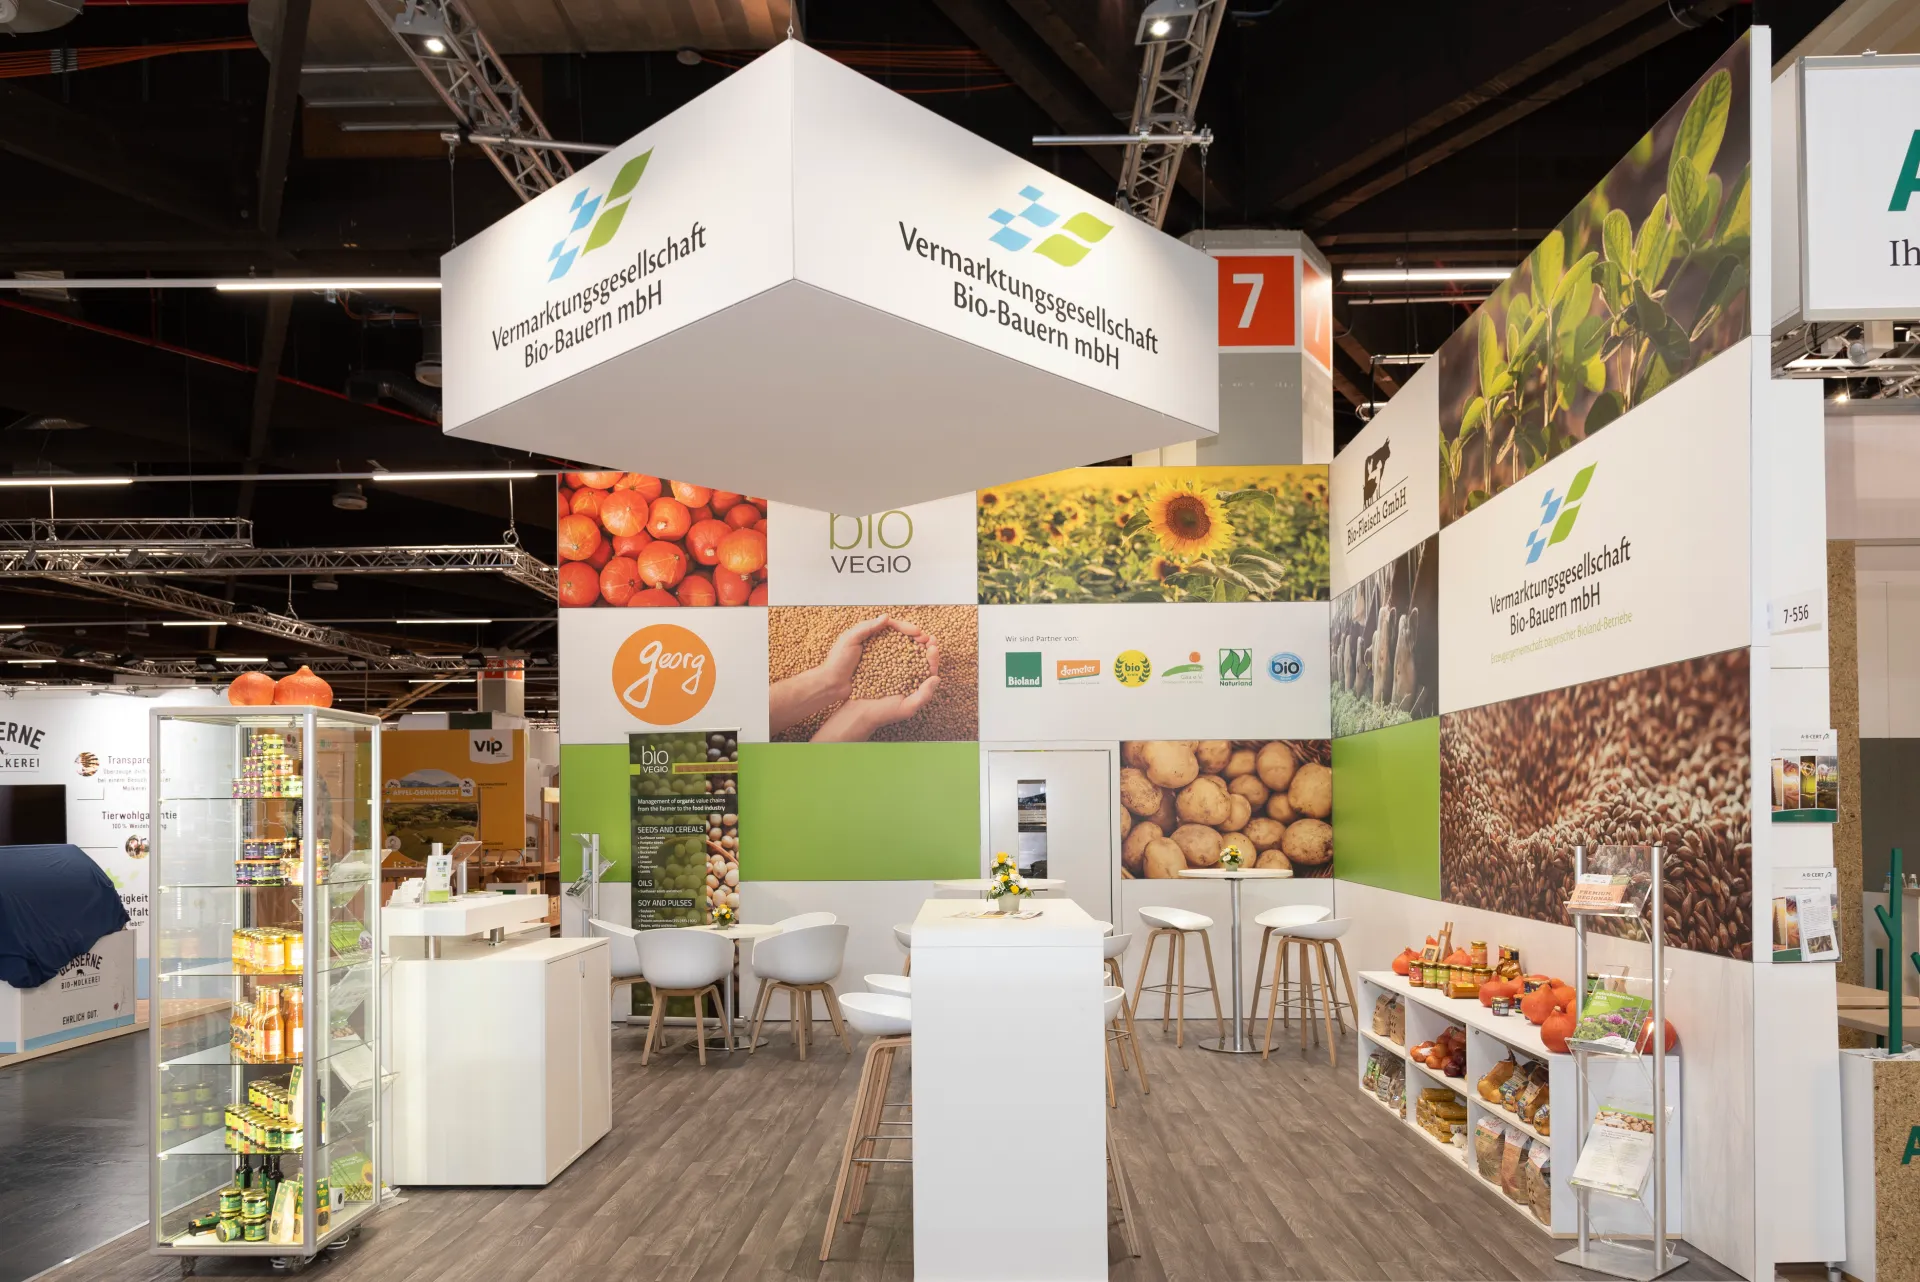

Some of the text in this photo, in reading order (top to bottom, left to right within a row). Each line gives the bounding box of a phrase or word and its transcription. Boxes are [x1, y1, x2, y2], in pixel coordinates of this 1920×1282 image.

[492, 221, 707, 351] Vermarktungsgesellschaft
[899, 221, 1159, 354] Vermarktungsgesellschaft
[1232, 273, 1264, 329] 7
[524, 279, 663, 368] Bio-Bauern mbH
[953, 281, 1119, 370] Bio-Bauern mbH
[1347, 486, 1407, 546] Bio-Fleisch GmbH
[830, 555, 912, 574] VEGIO
[1490, 535, 1632, 615] Vermarktungsgesellschaft
[1510, 581, 1601, 636] Bio-Bauern mbH
[1783, 604, 1809, 624] 7-556
[623, 640, 706, 709] georg
[1060, 664, 1096, 676] demeter
[1124, 662, 1141, 672] bio
[1008, 676, 1040, 686] Bioland
[474, 736, 503, 755] vip
[641, 745, 669, 766] bio
[642, 765, 669, 774] VEGIO
[637, 798, 670, 806] Management
[637, 826, 659, 834] SEEDS
[675, 825, 704, 833] CEREALS
[638, 879, 653, 887] OILS
[638, 899, 692, 907] SOY AND PULSES
[62, 1009, 99, 1026] EHRLICH GUT.
